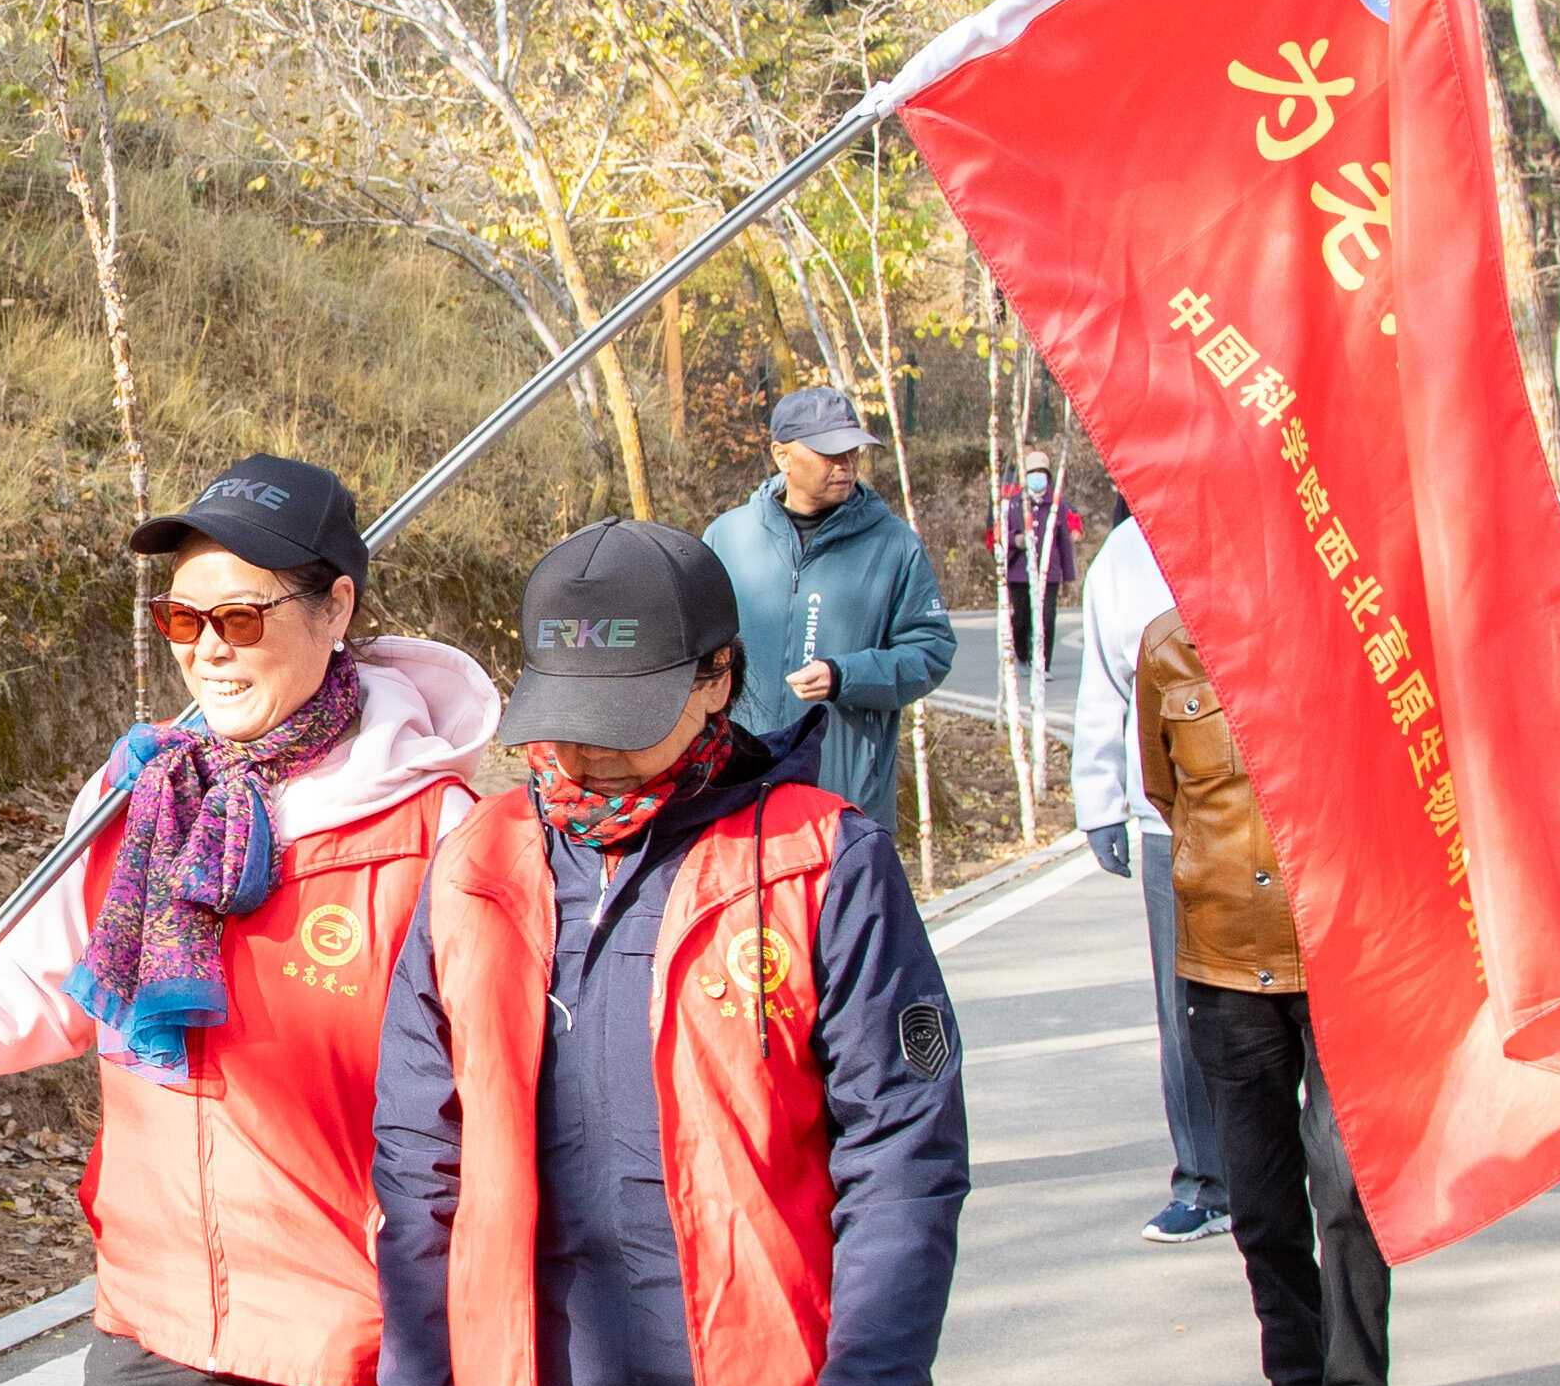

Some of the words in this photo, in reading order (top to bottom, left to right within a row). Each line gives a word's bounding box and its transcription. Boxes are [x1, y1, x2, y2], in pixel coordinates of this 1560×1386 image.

[197, 477, 291, 511] ERKE
[536, 618, 640, 649] ERKE
[282, 961, 358, 997] 西高爱心
